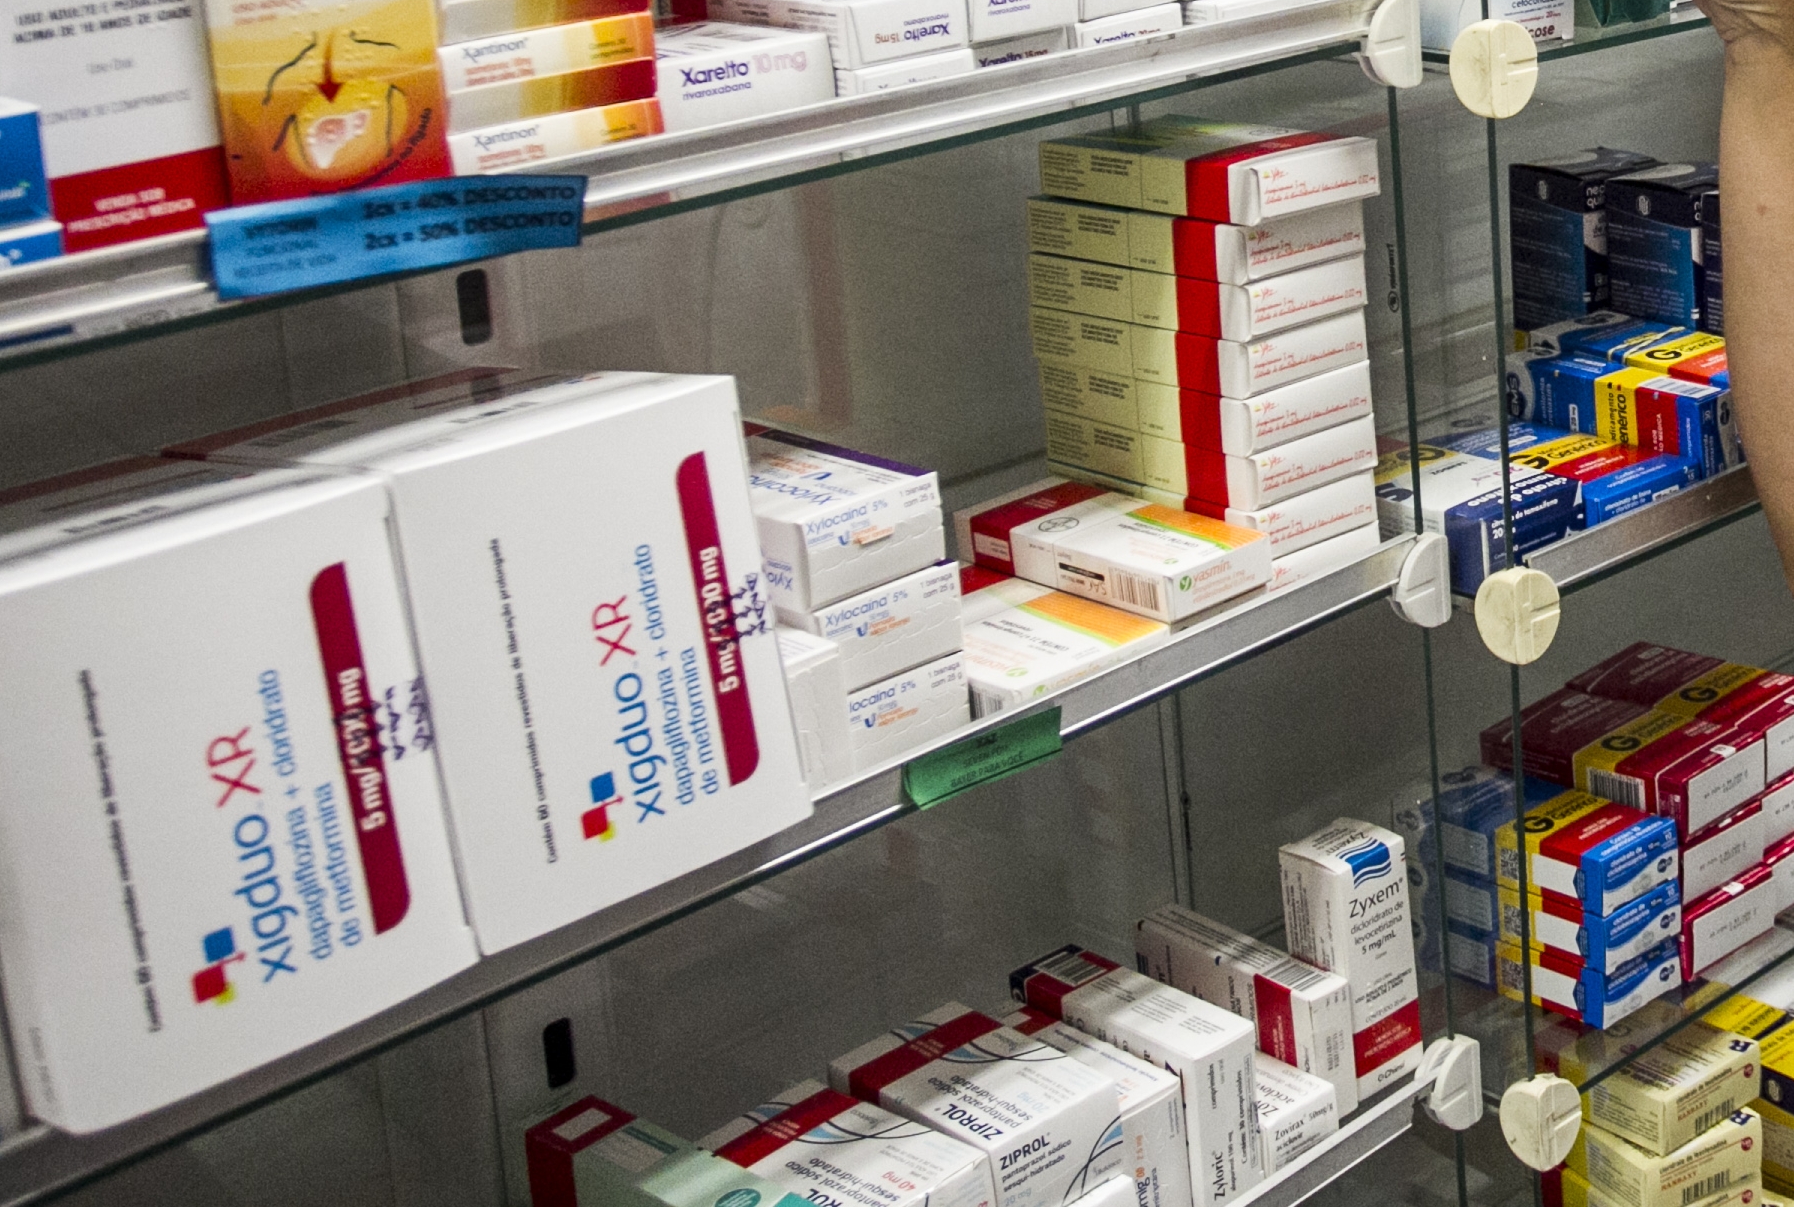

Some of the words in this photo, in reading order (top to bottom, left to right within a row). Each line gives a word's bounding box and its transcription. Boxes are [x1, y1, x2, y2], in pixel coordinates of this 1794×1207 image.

[61, 25, 75, 37] DE
[138, 12, 152, 25] DE
[988, 4, 1031, 17] rivaroxabana
[903, 22, 950, 42] Xarelto
[1531, 24, 1555, 39] cose
[462, 38, 527, 63] Xantinon
[680, 60, 749, 88] Xarelto
[682, 81, 752, 101] rivaroxabana
[474, 125, 538, 152] Xantinon
[464, 186, 576, 205] DESCONTO
[465, 211, 575, 234] DESCONTO
[1646, 349, 1681, 361] G
[872, 499, 888, 512] 5%
[490, 537, 511, 601] prolongada
[700, 546, 721, 581] mg
[634, 544, 667, 643] cloridrato
[893, 589, 908, 603] 5%
[502, 602, 518, 655] liberação
[591, 594, 637, 667] XR
[510, 655, 521, 671] de
[337, 667, 364, 707] mg
[515, 671, 533, 729] revestidos
[719, 676, 740, 693] 5
[901, 679, 916, 693] 5%
[680, 646, 714, 766] metformina
[258, 669, 298, 778] cloridrato
[658, 667, 693, 806] dapagliflozina
[613, 671, 666, 826] xigduo
[1601, 735, 1641, 752] G
[206, 726, 262, 808] XR
[526, 730, 547, 803] comprimidos
[699, 770, 719, 795] de
[360, 810, 387, 832] 5
[537, 803, 550, 822] 60
[1513, 816, 1554, 833] G
[312, 781, 358, 912] metformina
[543, 821, 559, 865] Contém
[231, 811, 296, 985] xigduo
[291, 803, 330, 962] dapagliflozina
[1349, 881, 1400, 918] Zyxem
[338, 915, 363, 947] de
[1350, 906, 1393, 935] dicloridrato
[1393, 900, 1404, 913] de
[1354, 915, 1403, 946] levocetirizina
[1361, 945, 1368, 955] 5
[1368, 929, 1397, 952] mg/mL
[950, 1074, 1033, 1121] sesqui-hidratado
[1208, 1063, 1217, 1109] comprimidos
[1236, 1070, 1245, 1120] comprimidos
[944, 1103, 1005, 1141] ZIPROL
[1274, 1119, 1304, 1141] Zovirax
[1000, 1136, 1049, 1170] ZIPROL
[1276, 1132, 1303, 1152] aciclovir
[1001, 1152, 1047, 1183] pantoprazol
[1046, 1138, 1072, 1158] sódico
[1003, 1153, 1065, 1192] sesqui-hidratado
[1213, 1151, 1226, 1201] Zyloric
